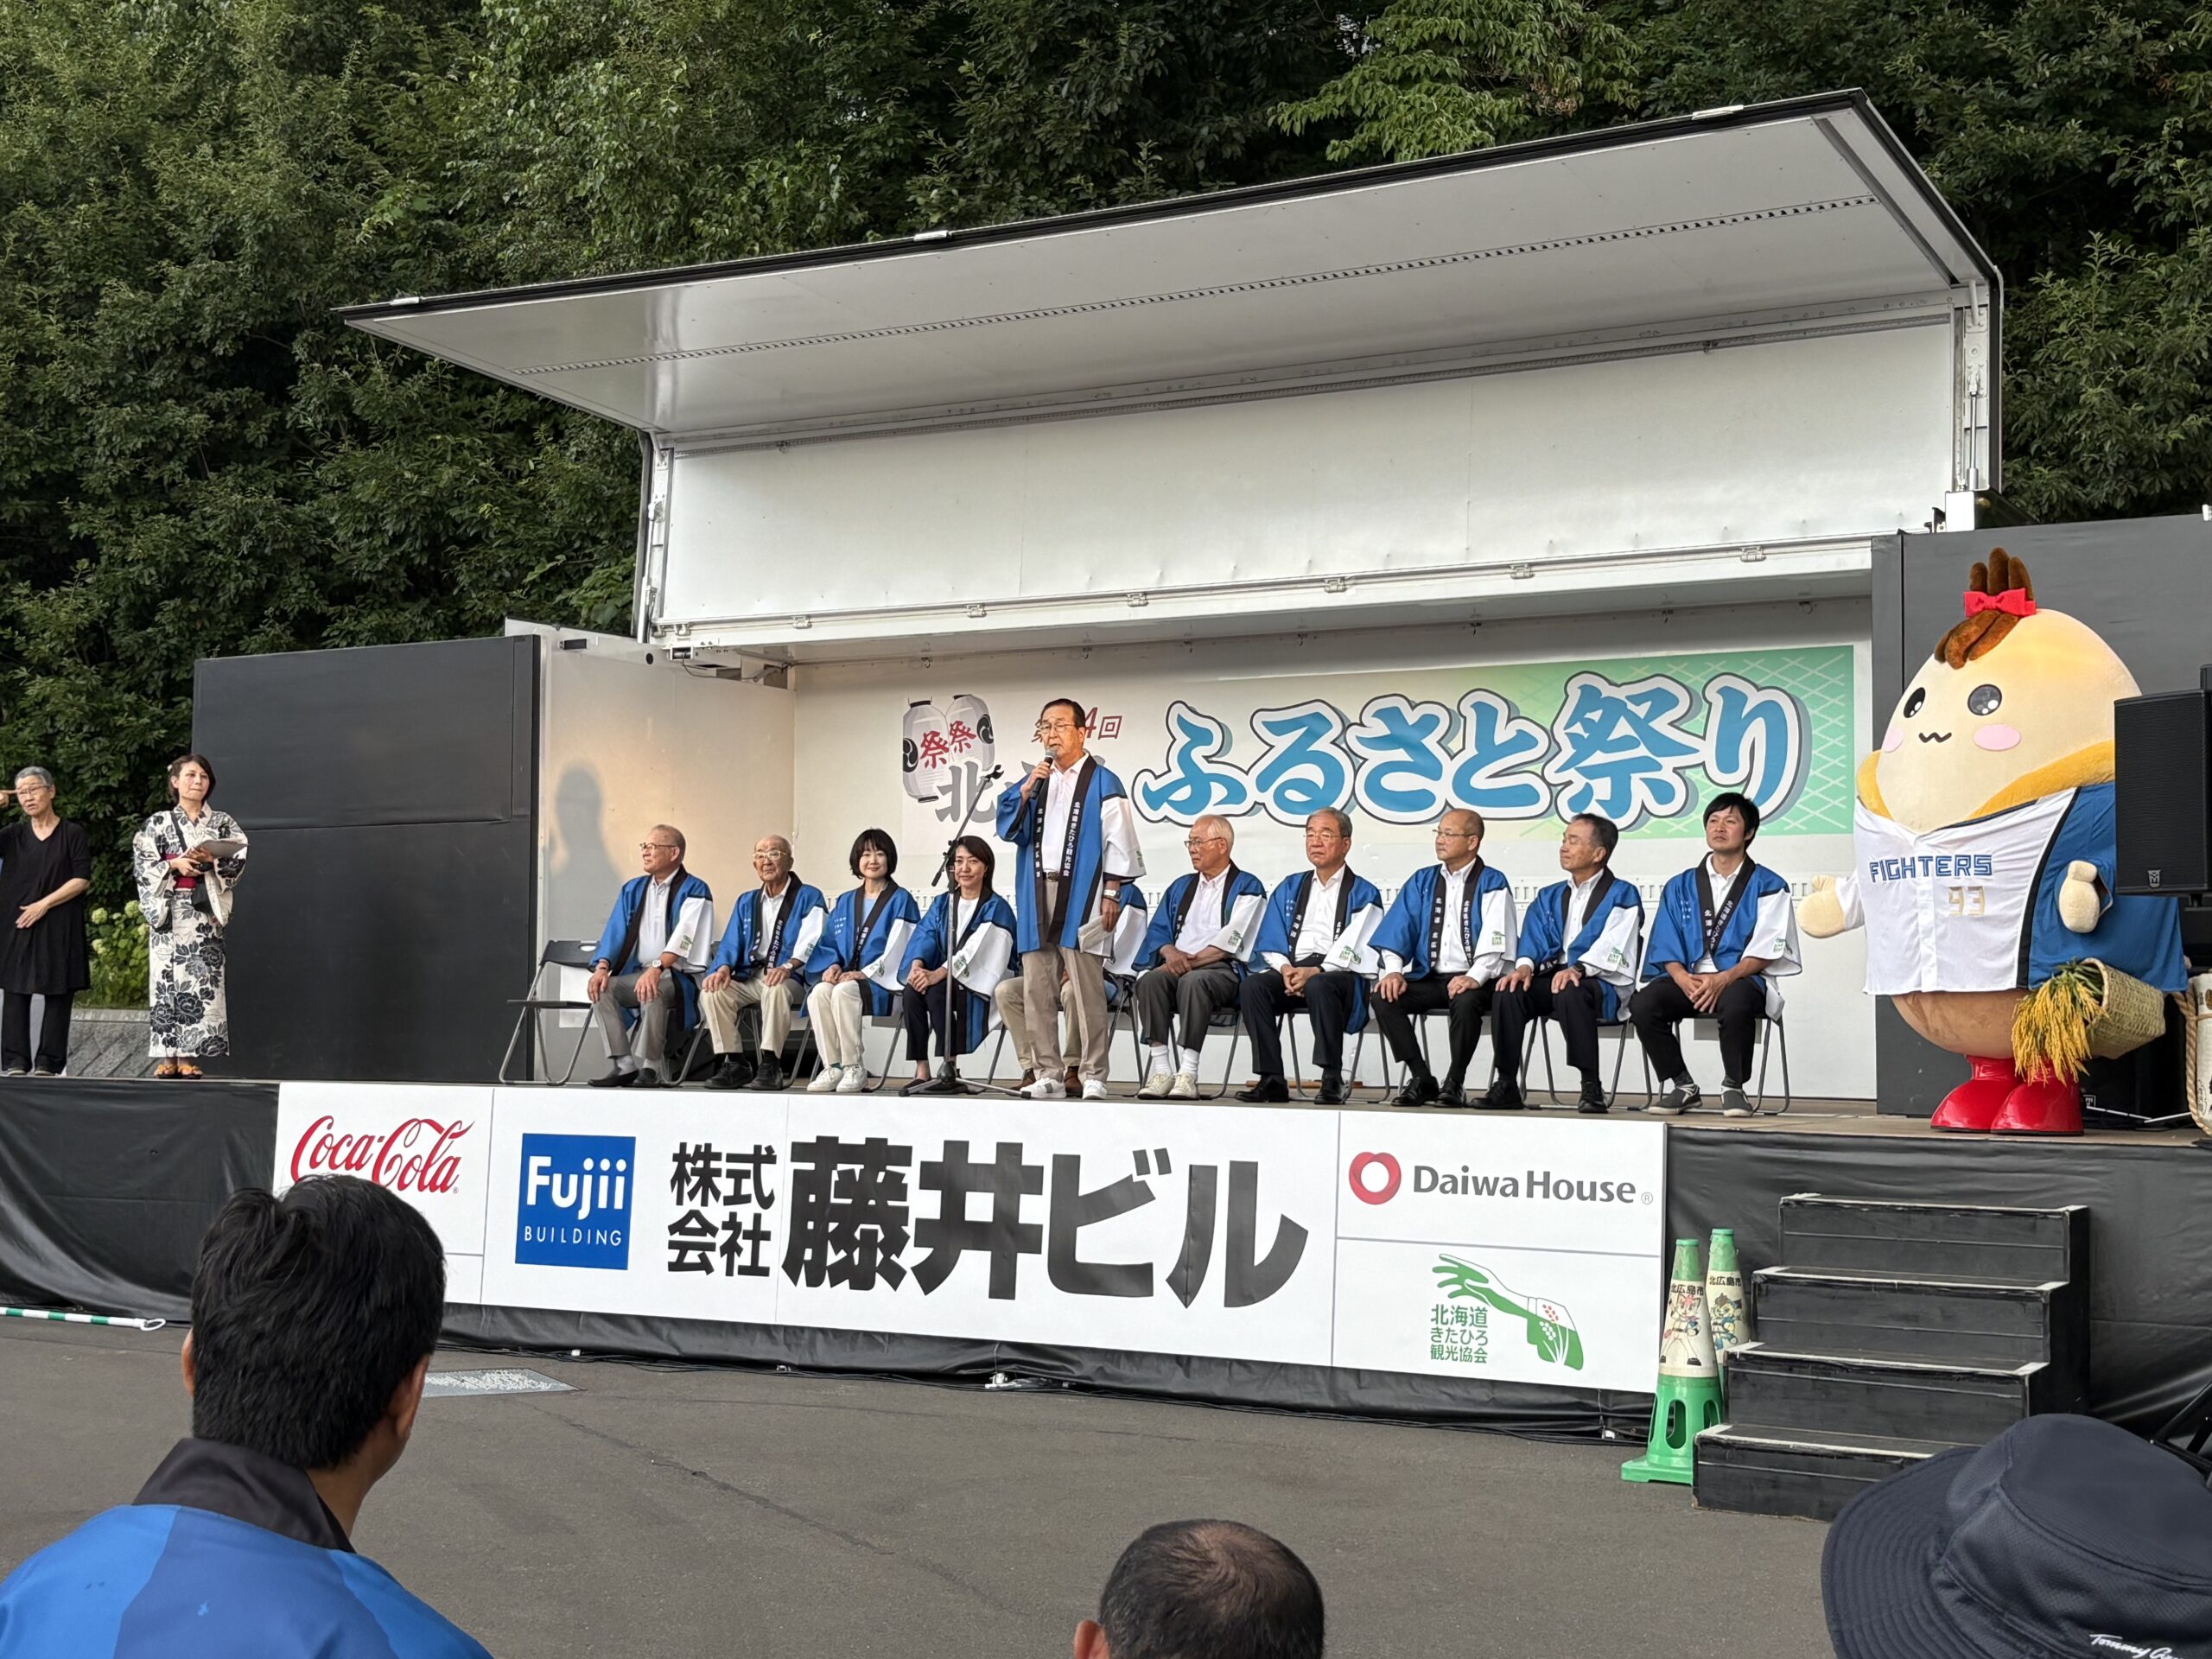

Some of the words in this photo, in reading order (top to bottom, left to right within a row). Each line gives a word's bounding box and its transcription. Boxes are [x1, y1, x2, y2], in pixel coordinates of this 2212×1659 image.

[920, 731, 949, 769] 祭
[950, 720, 976, 753] 祭
[1135, 674, 1802, 827] ふるさと祭り
[1869, 854, 1993, 883] FIGHTERS
[1948, 886, 1986, 916] 93
[290, 1116, 475, 1193] Coca-Cola
[526, 1155, 627, 1221] Fujii
[671, 1141, 777, 1210] 株式
[1414, 1165, 1519, 1198] Daiwa
[1526, 1170, 1637, 1204] House
[524, 1225, 622, 1247] BUILDING
[782, 1135, 1309, 1309] 藤井ビル
[667, 1209, 772, 1277] 会社
[1671, 1283, 1704, 1296] 北広島市
[1708, 1275, 1742, 1287] 北広島市
[1430, 1303, 1488, 1328] 北海道
[1430, 1326, 1488, 1346] きたひろ
[1430, 1344, 1488, 1364] 観光協会
[2088, 1633, 2152, 1659] Tommy
